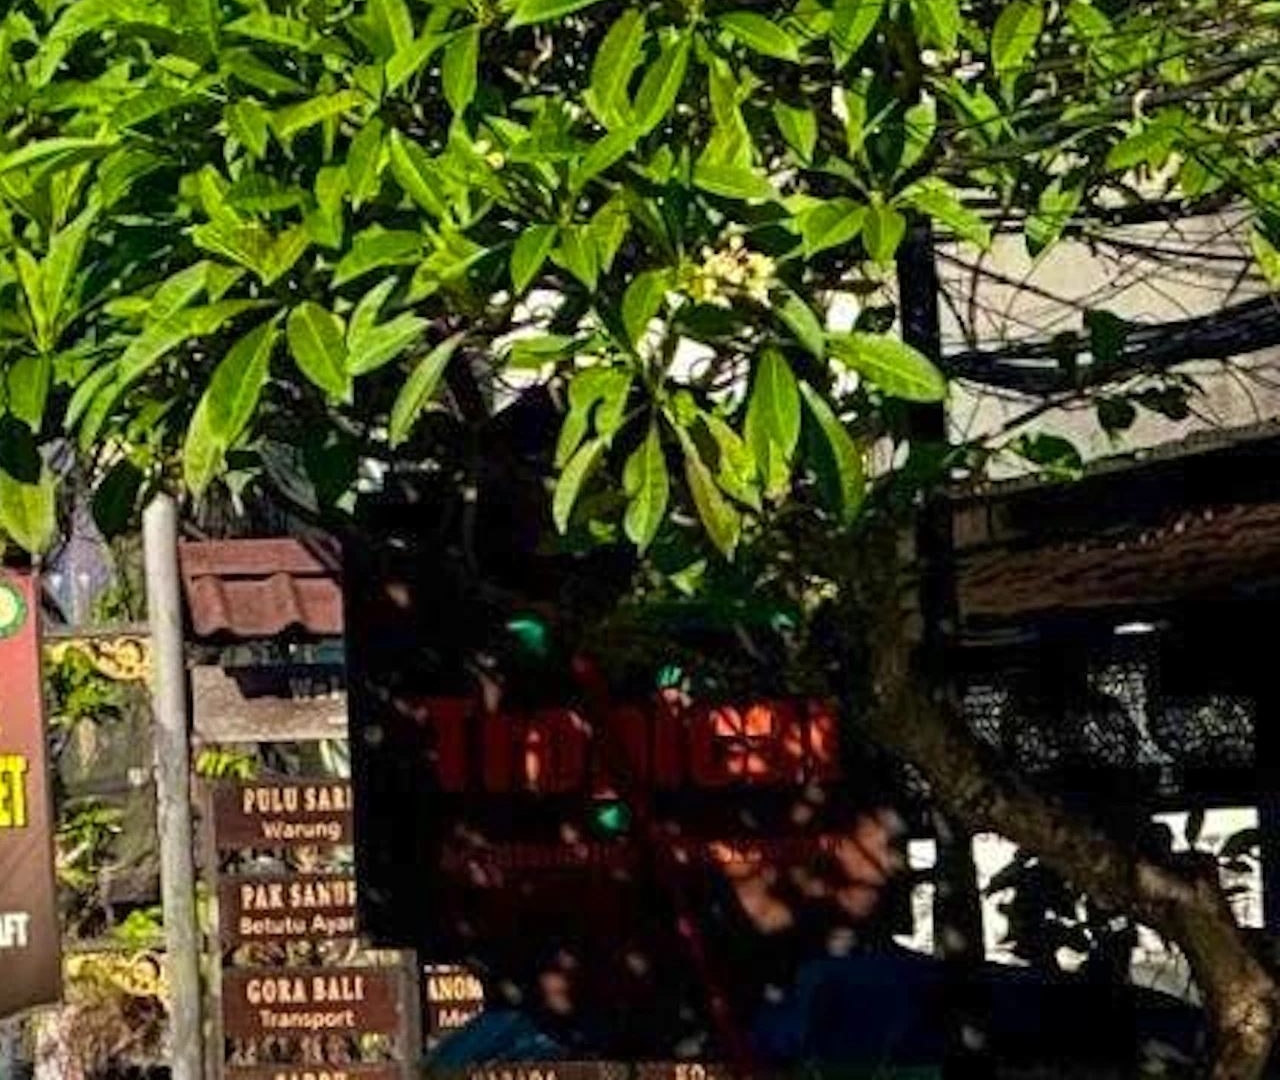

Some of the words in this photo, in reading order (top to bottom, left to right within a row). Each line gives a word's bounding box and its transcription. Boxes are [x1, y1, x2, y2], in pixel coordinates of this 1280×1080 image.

[262, 820, 342, 841] Warung
[241, 883, 284, 910] PAK
[313, 975, 365, 1001] BALI
[259, 1008, 356, 1029] Transport
